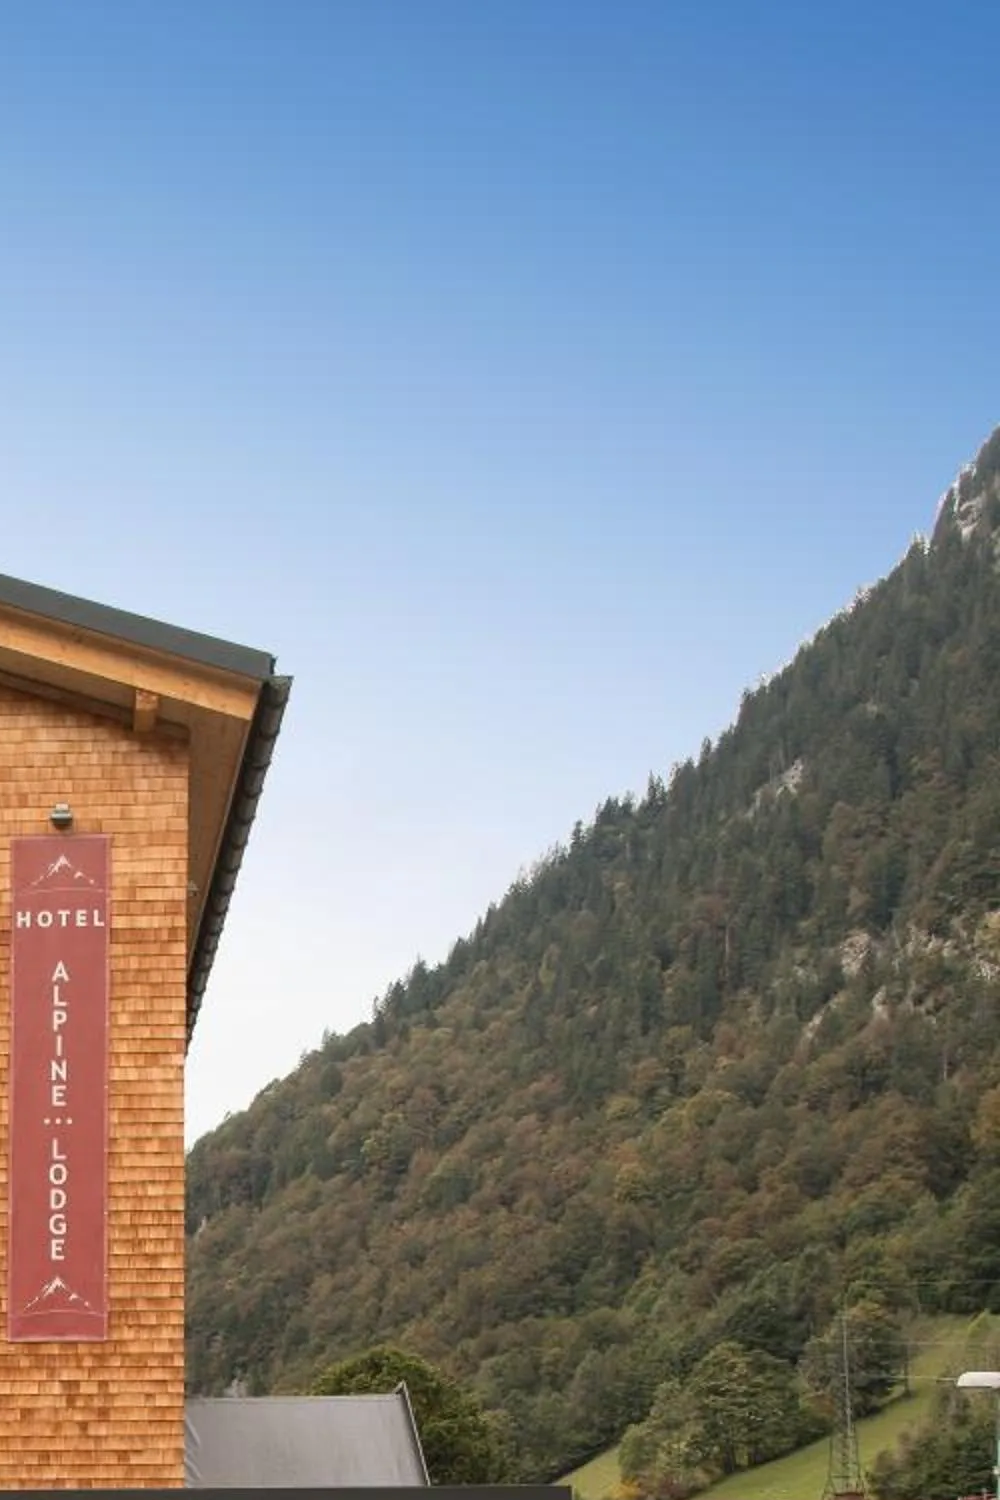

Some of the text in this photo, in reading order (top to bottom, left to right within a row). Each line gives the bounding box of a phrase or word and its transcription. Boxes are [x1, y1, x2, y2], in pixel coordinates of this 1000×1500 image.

[16, 910, 105, 928] HOTEL
[49, 960, 70, 1260] ALPINE LODGE
